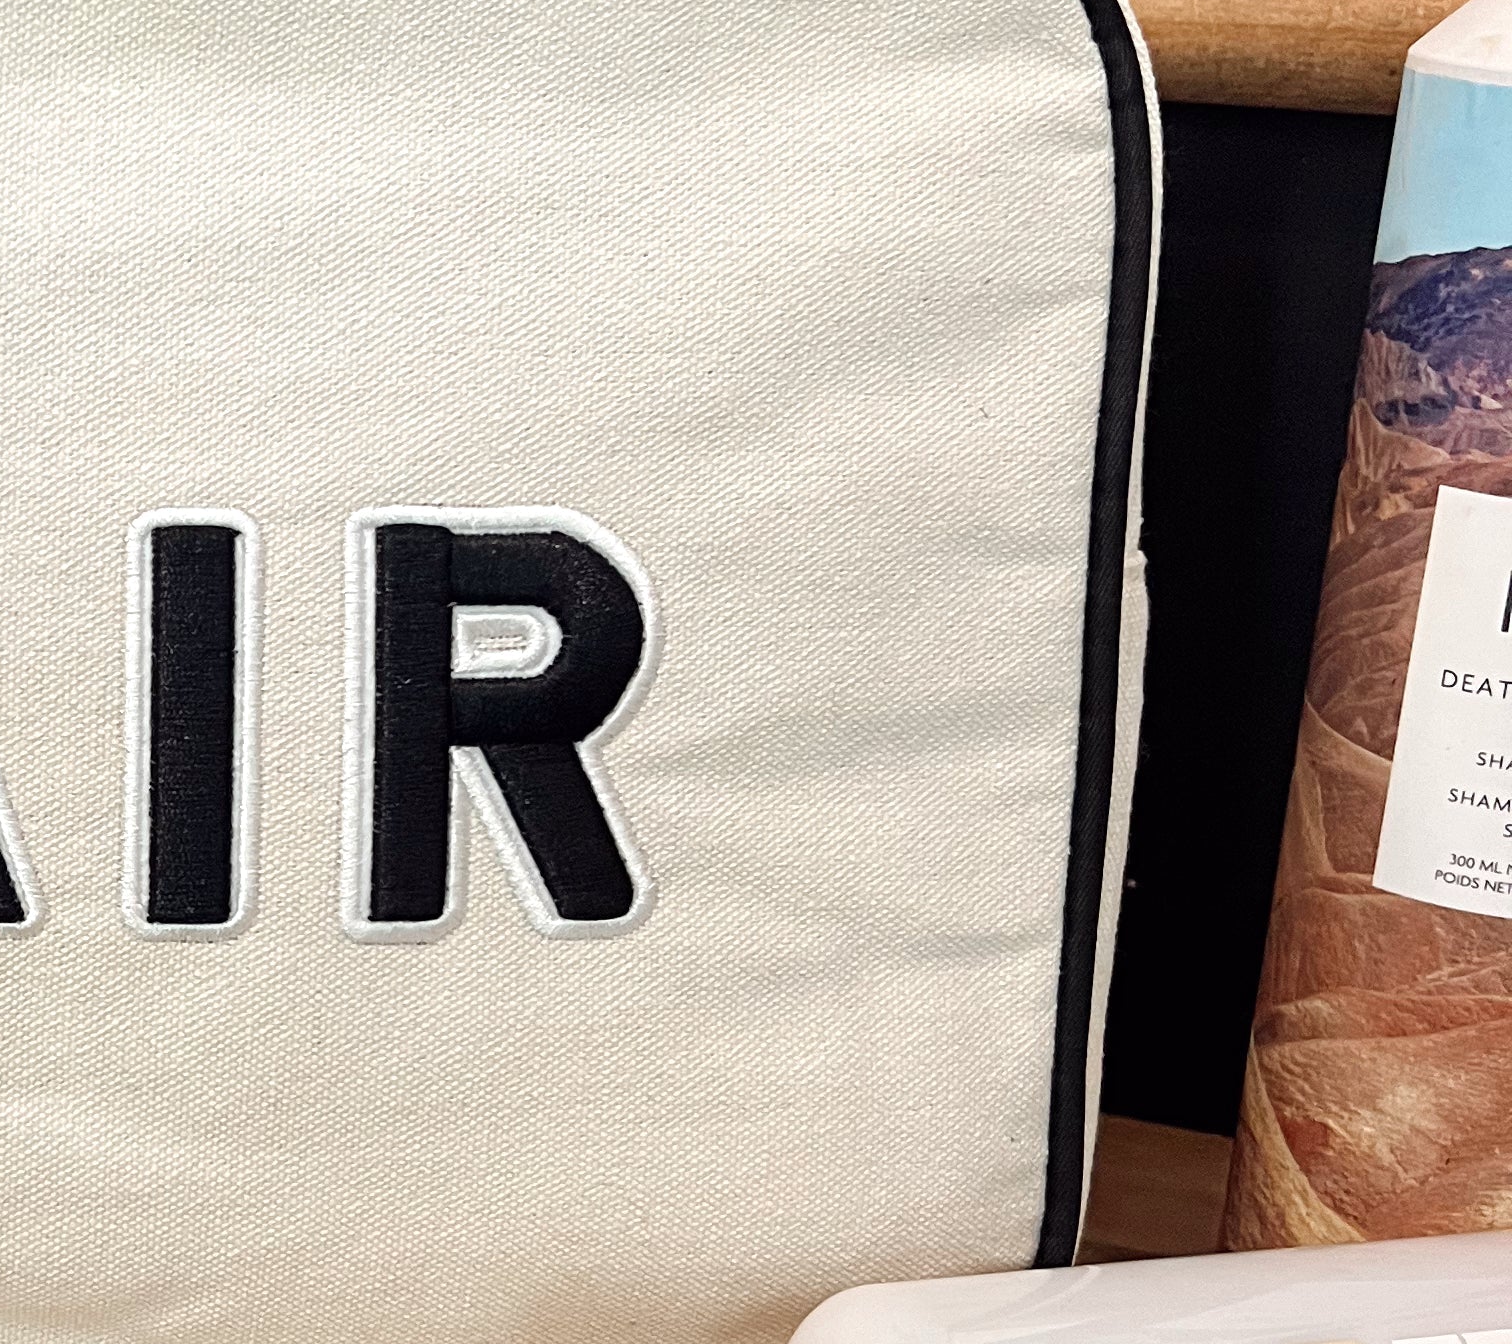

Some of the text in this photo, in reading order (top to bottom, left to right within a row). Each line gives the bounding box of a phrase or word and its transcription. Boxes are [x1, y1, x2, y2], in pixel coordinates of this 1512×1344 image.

[1441, 669, 1512, 699] DEAT
[1448, 788, 1512, 813] SHAM
[1449, 853, 1475, 869] 300
[1479, 860, 1502, 874] ML
[1434, 869, 1512, 895] POIDS NET
